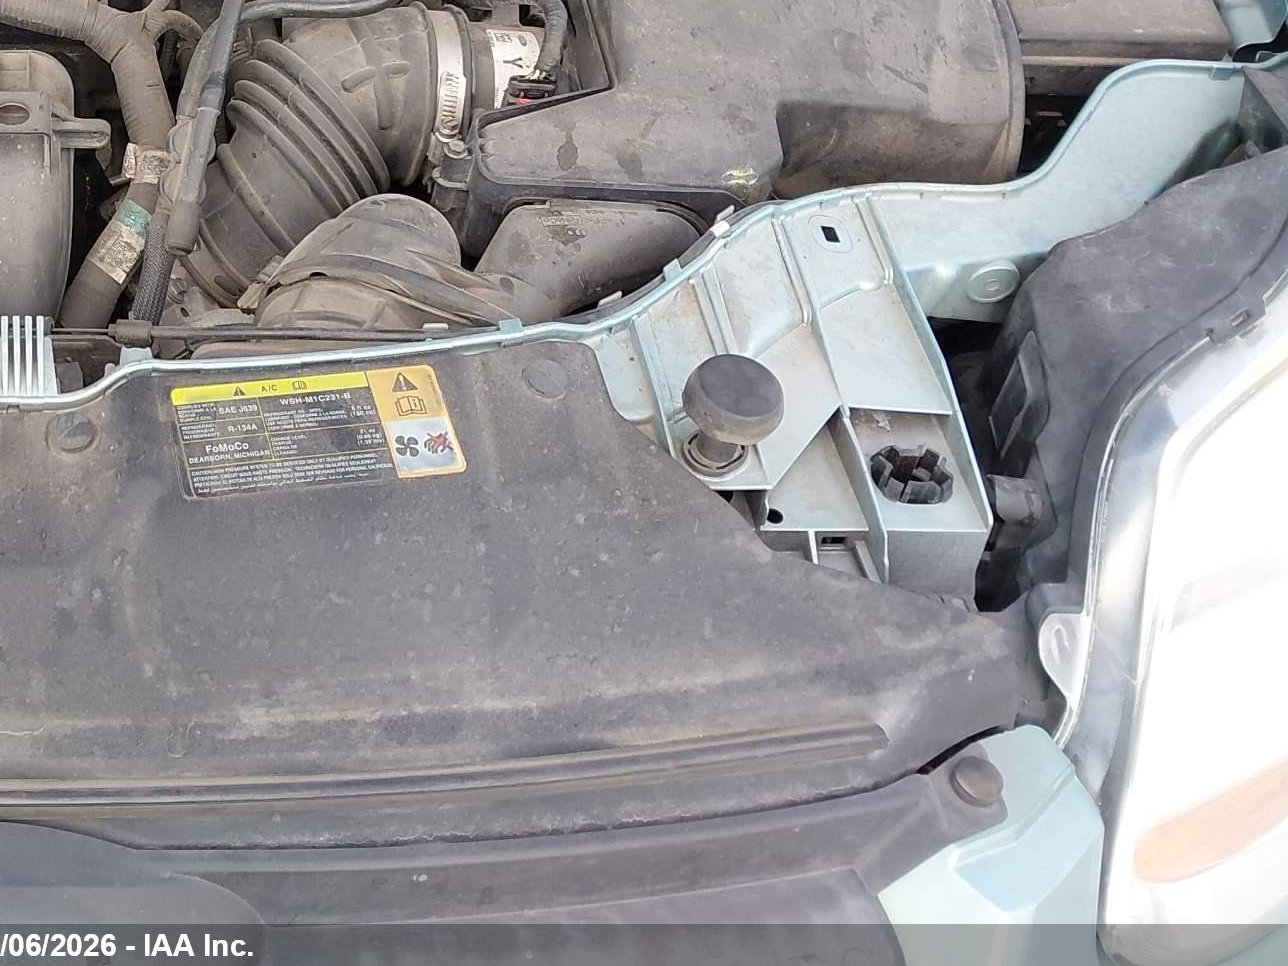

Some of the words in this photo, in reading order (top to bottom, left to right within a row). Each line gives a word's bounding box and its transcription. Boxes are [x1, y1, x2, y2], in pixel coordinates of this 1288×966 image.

[261, 384, 278, 392] A/C
[279, 392, 351, 405] WSH-M1C231-B
[219, 406, 237, 414] SAE
[228, 423, 258, 432] R-134A
[205, 441, 249, 454] FoMoCo
[233, 449, 271, 459] MICHIGAN
